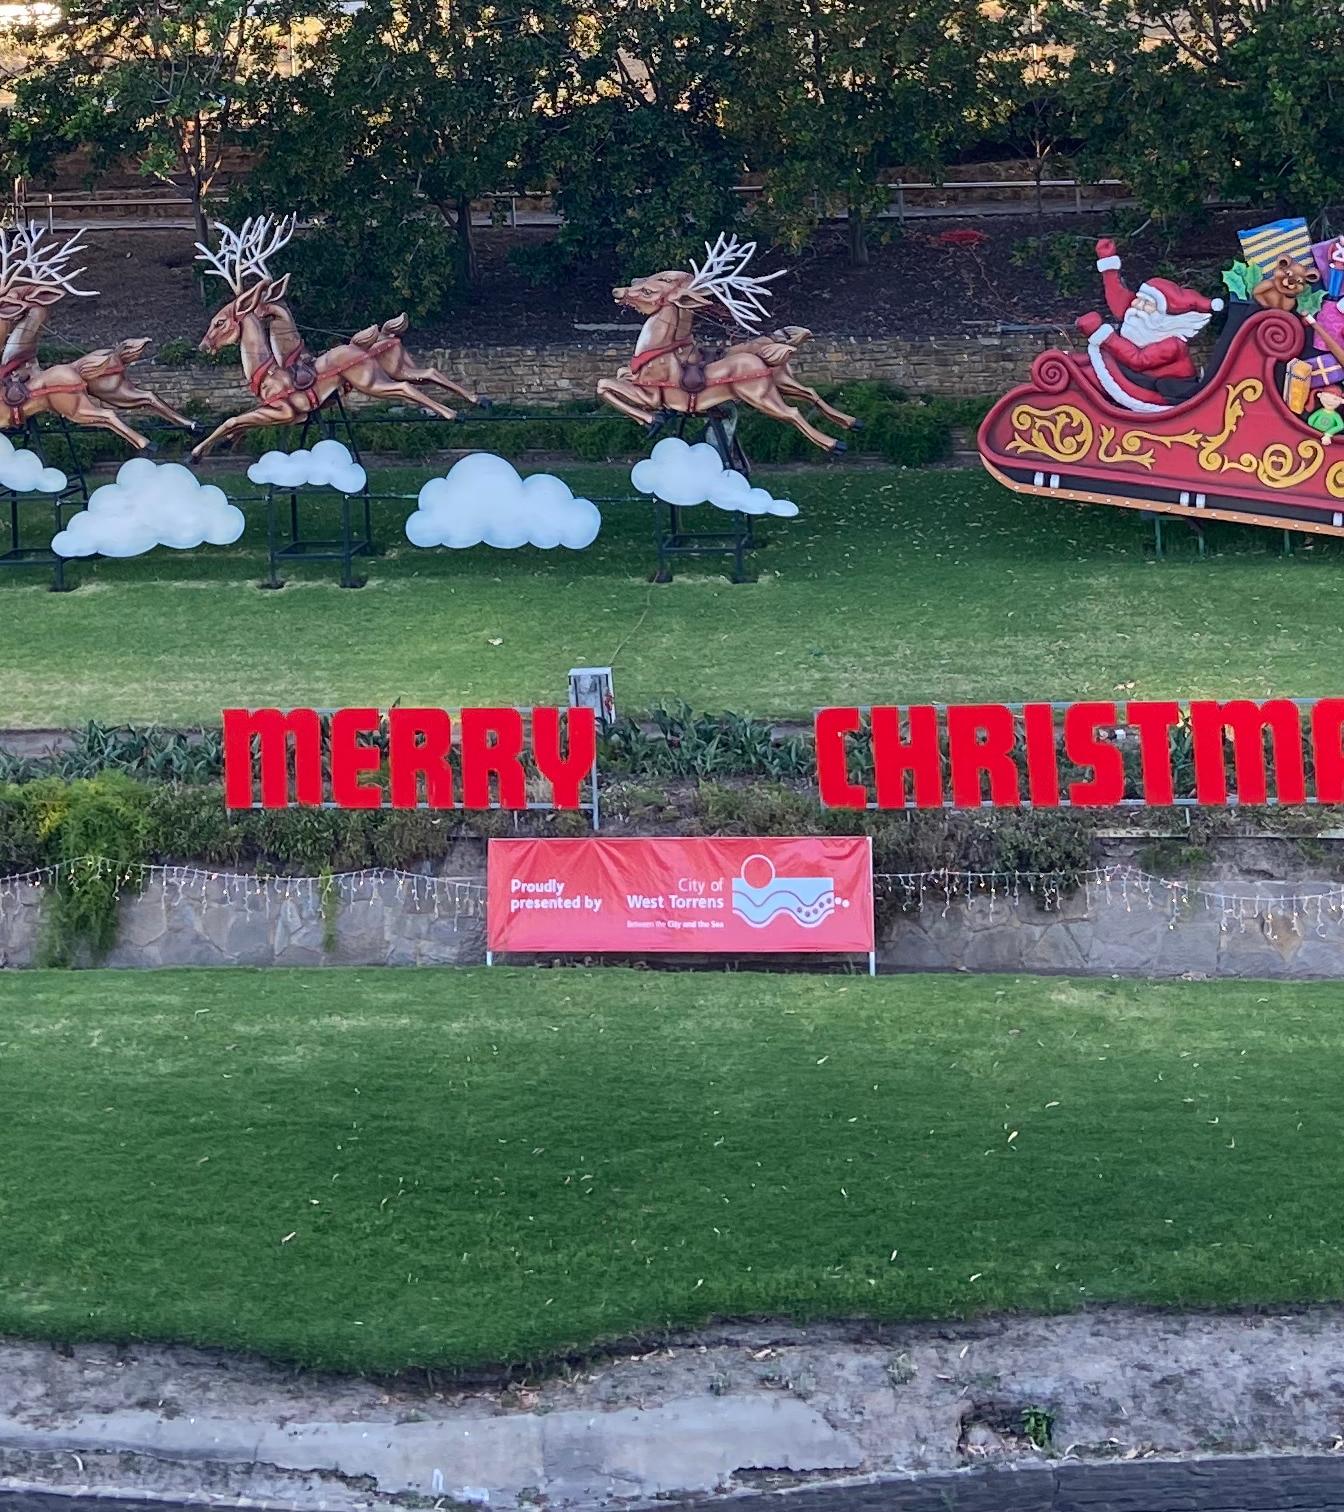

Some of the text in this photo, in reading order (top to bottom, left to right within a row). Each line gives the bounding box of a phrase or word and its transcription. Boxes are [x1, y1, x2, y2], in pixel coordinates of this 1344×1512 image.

[221, 706, 596, 810] MERRY
[510, 879, 565, 896] Proudly
[678, 877, 725, 895] City of
[510, 895, 603, 913] presented by
[626, 894, 725, 909] West Torrens
[667, 919, 682, 929] City
[682, 920, 697, 928] and
